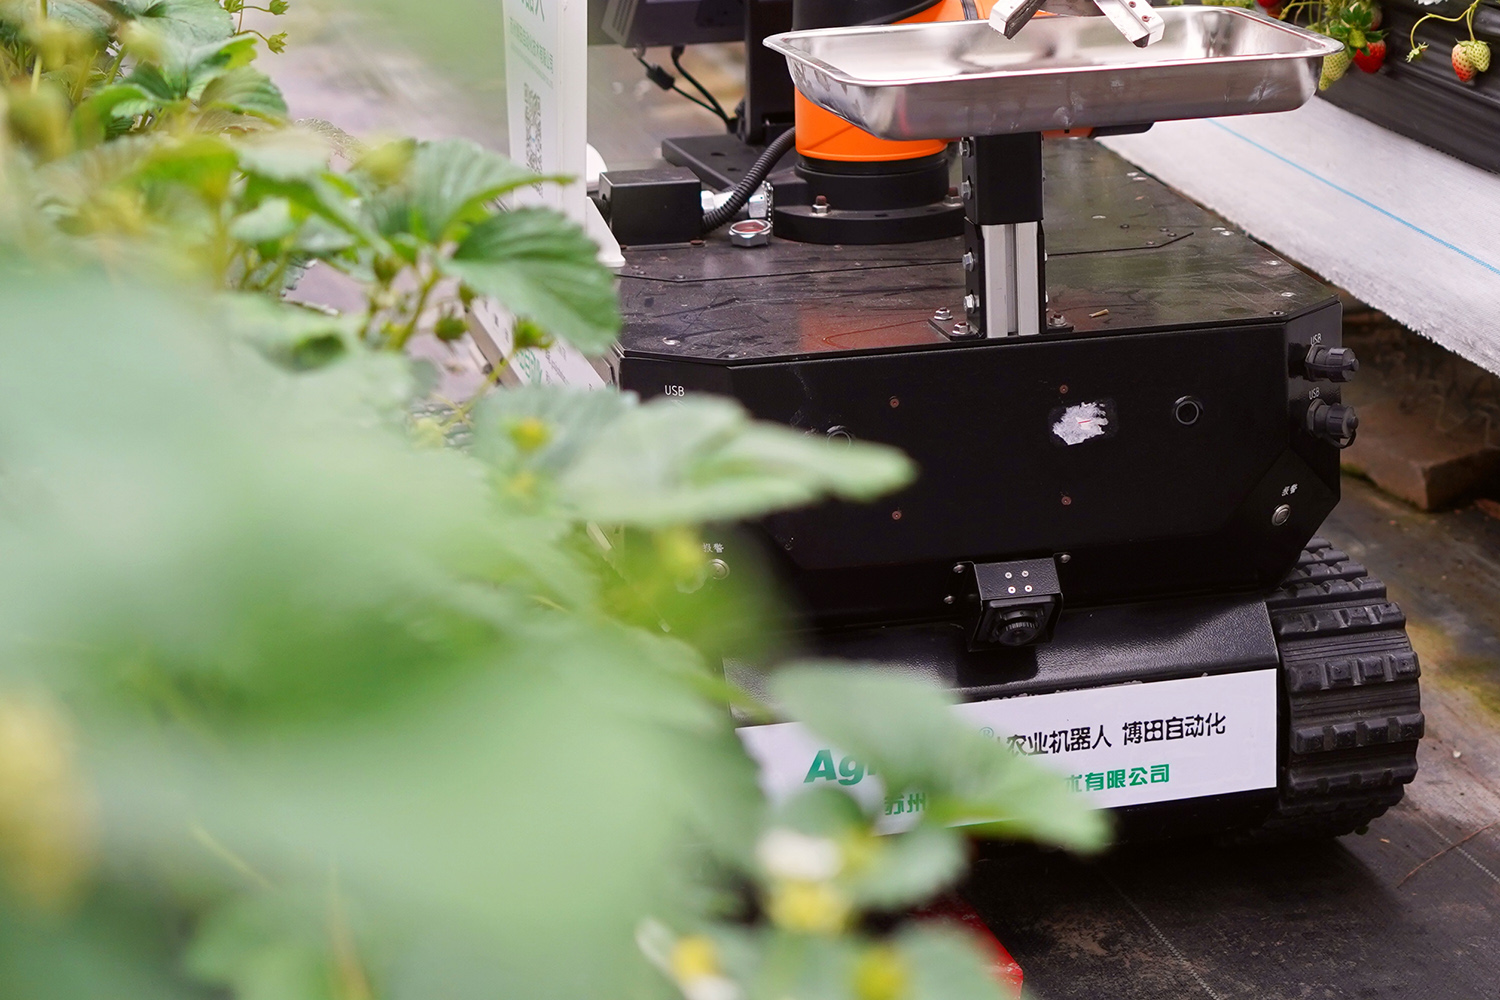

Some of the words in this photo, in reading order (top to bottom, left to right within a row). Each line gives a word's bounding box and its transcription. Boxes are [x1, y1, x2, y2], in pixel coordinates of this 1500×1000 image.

[663, 384, 685, 397] USB
[1308, 386, 1320, 400] USB
[1005, 724, 1112, 756] 农业机器人
[1121, 711, 1227, 746] 博田自动化
